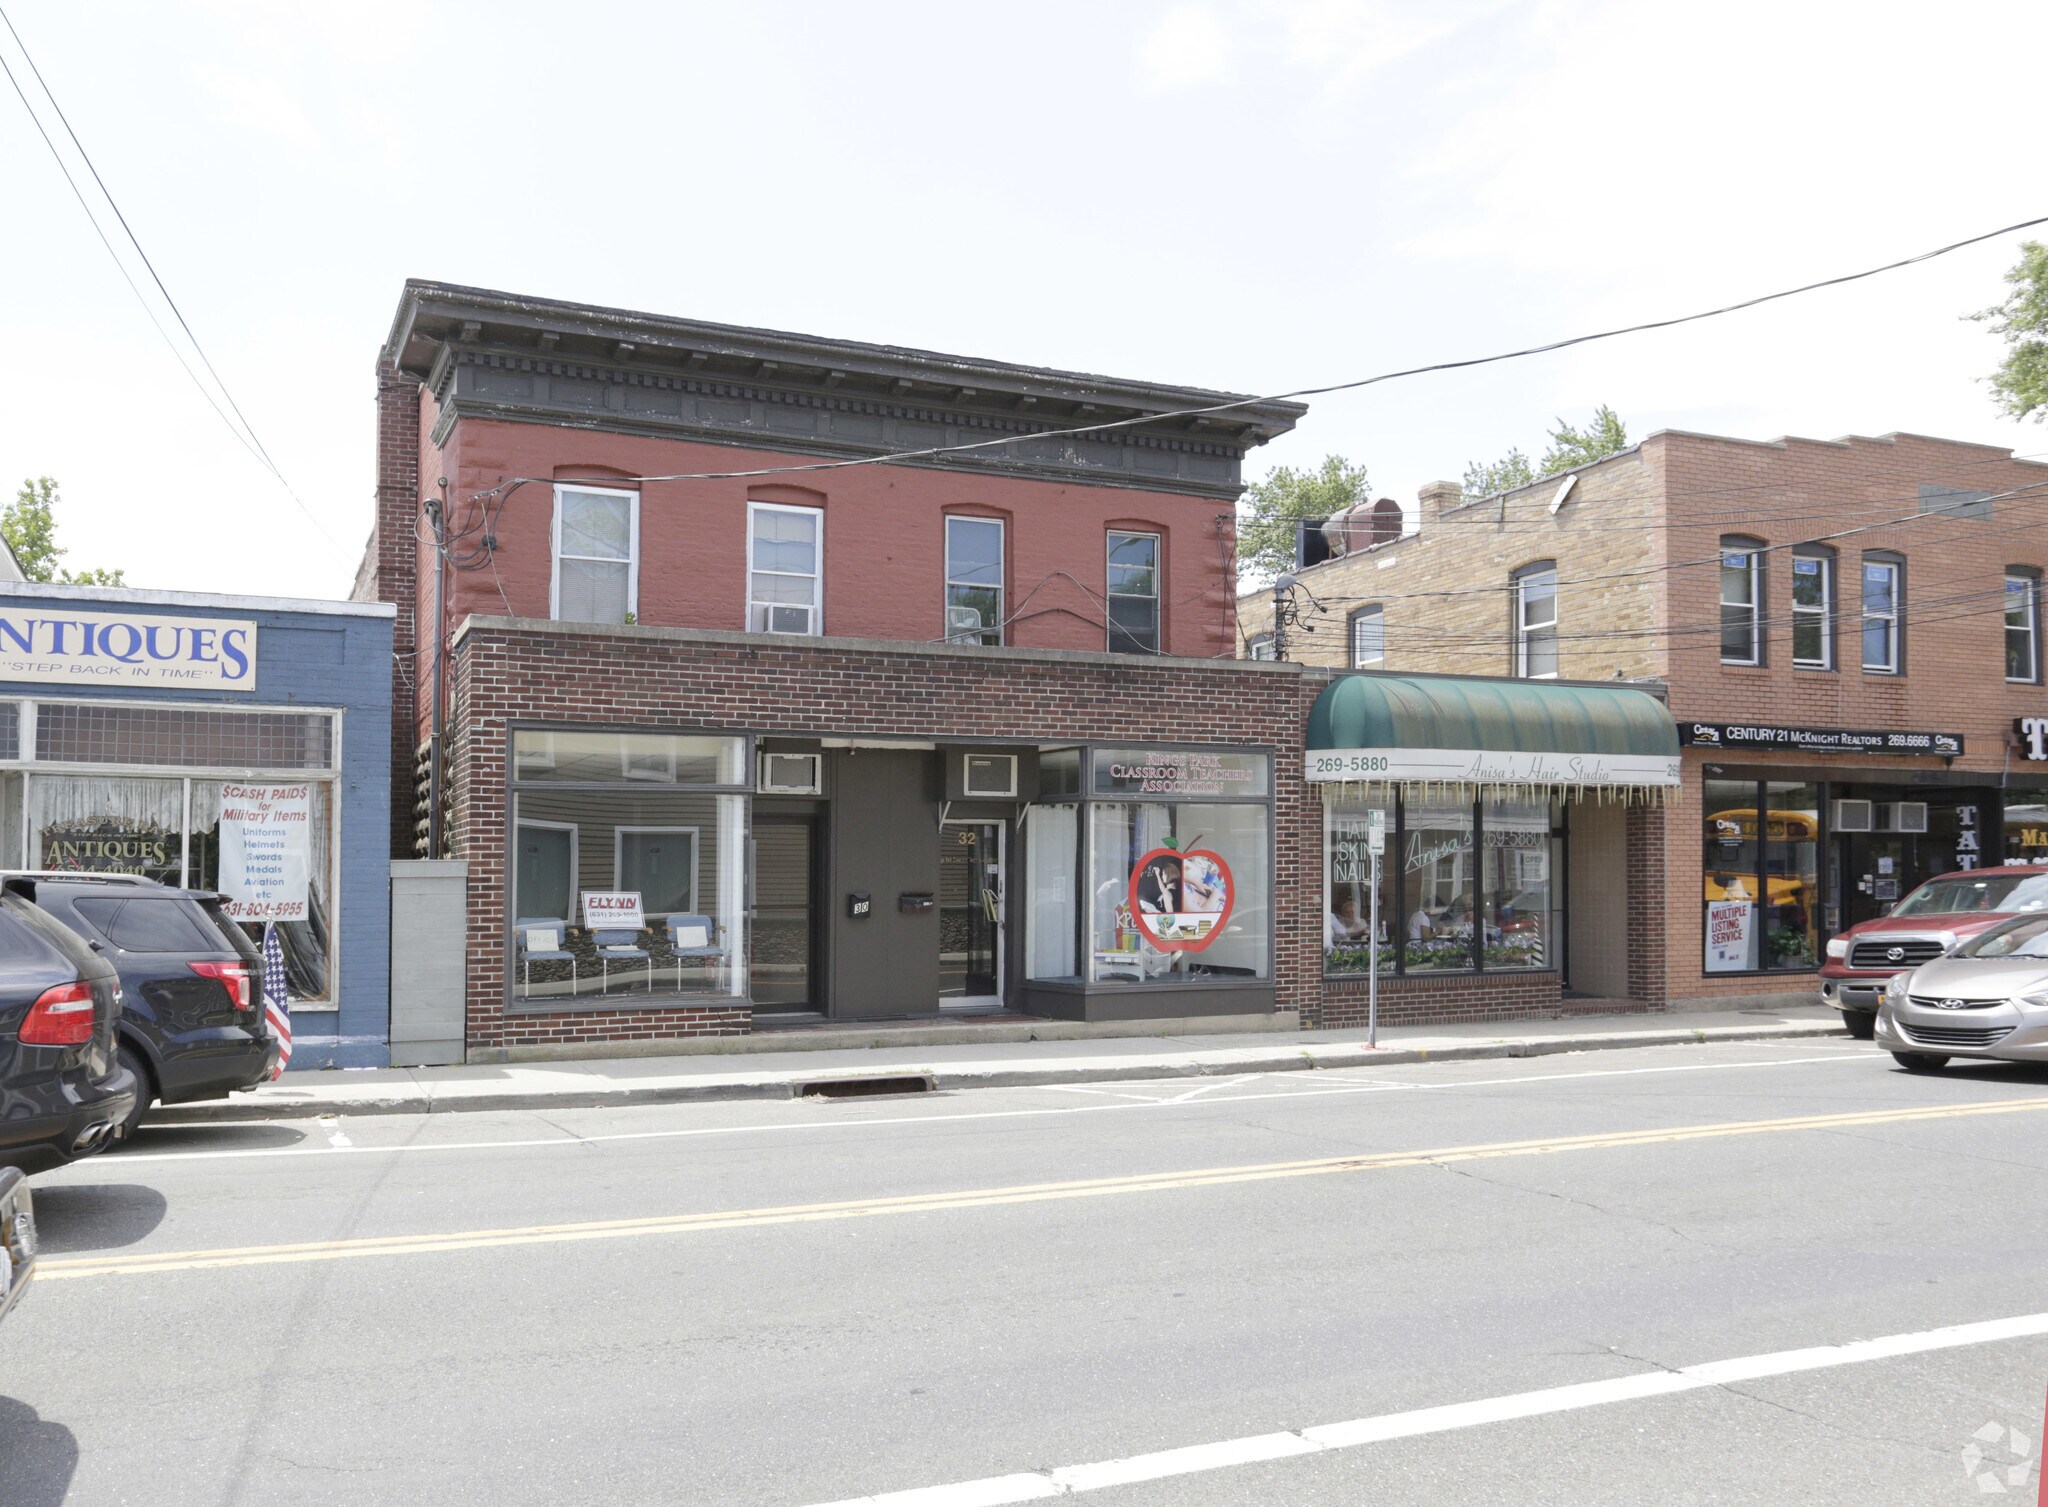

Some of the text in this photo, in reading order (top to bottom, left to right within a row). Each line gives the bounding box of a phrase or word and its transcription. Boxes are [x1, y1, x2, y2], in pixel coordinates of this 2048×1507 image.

[69, 665, 122, 676] BACK
[131, 667, 150, 677] IN
[1726, 726, 1776, 742] CENTURY
[1776, 729, 1788, 742] 21
[1840, 733, 1882, 746] REALTORS
[1888, 734, 1930, 747] 269.6666
[1145, 752, 1222, 768] KINGS PARK
[1316, 756, 1388, 773] 269-5880
[1458, 753, 1609, 781] Anisa's Hair Studio
[1109, 764, 1253, 781] CLASSROOM TEACHERS
[222, 784, 308, 800] $CASH PAID$
[1140, 778, 1224, 793] ASSOCIATION
[258, 801, 272, 812] for
[222, 808, 307, 824] Military Items
[242, 827, 287, 837] Uniforms
[1338, 820, 1369, 840] HAI
[243, 840, 285, 849] Helmets
[957, 831, 977, 845] 32
[45, 840, 166, 866] ANTIQUES
[246, 852, 282, 861] Swords
[246, 865, 282, 874] Medals
[244, 878, 285, 886] Aviation
[255, 890, 272, 899] etc
[588, 897, 637, 909] FLYNN
[854, 902, 869, 914] 30
[589, 911, 607, 919] (631)
[1711, 905, 1747, 921] MULTIPLE
[1711, 918, 1740, 933] LISTING
[1711, 929, 1743, 945] SERVICE
